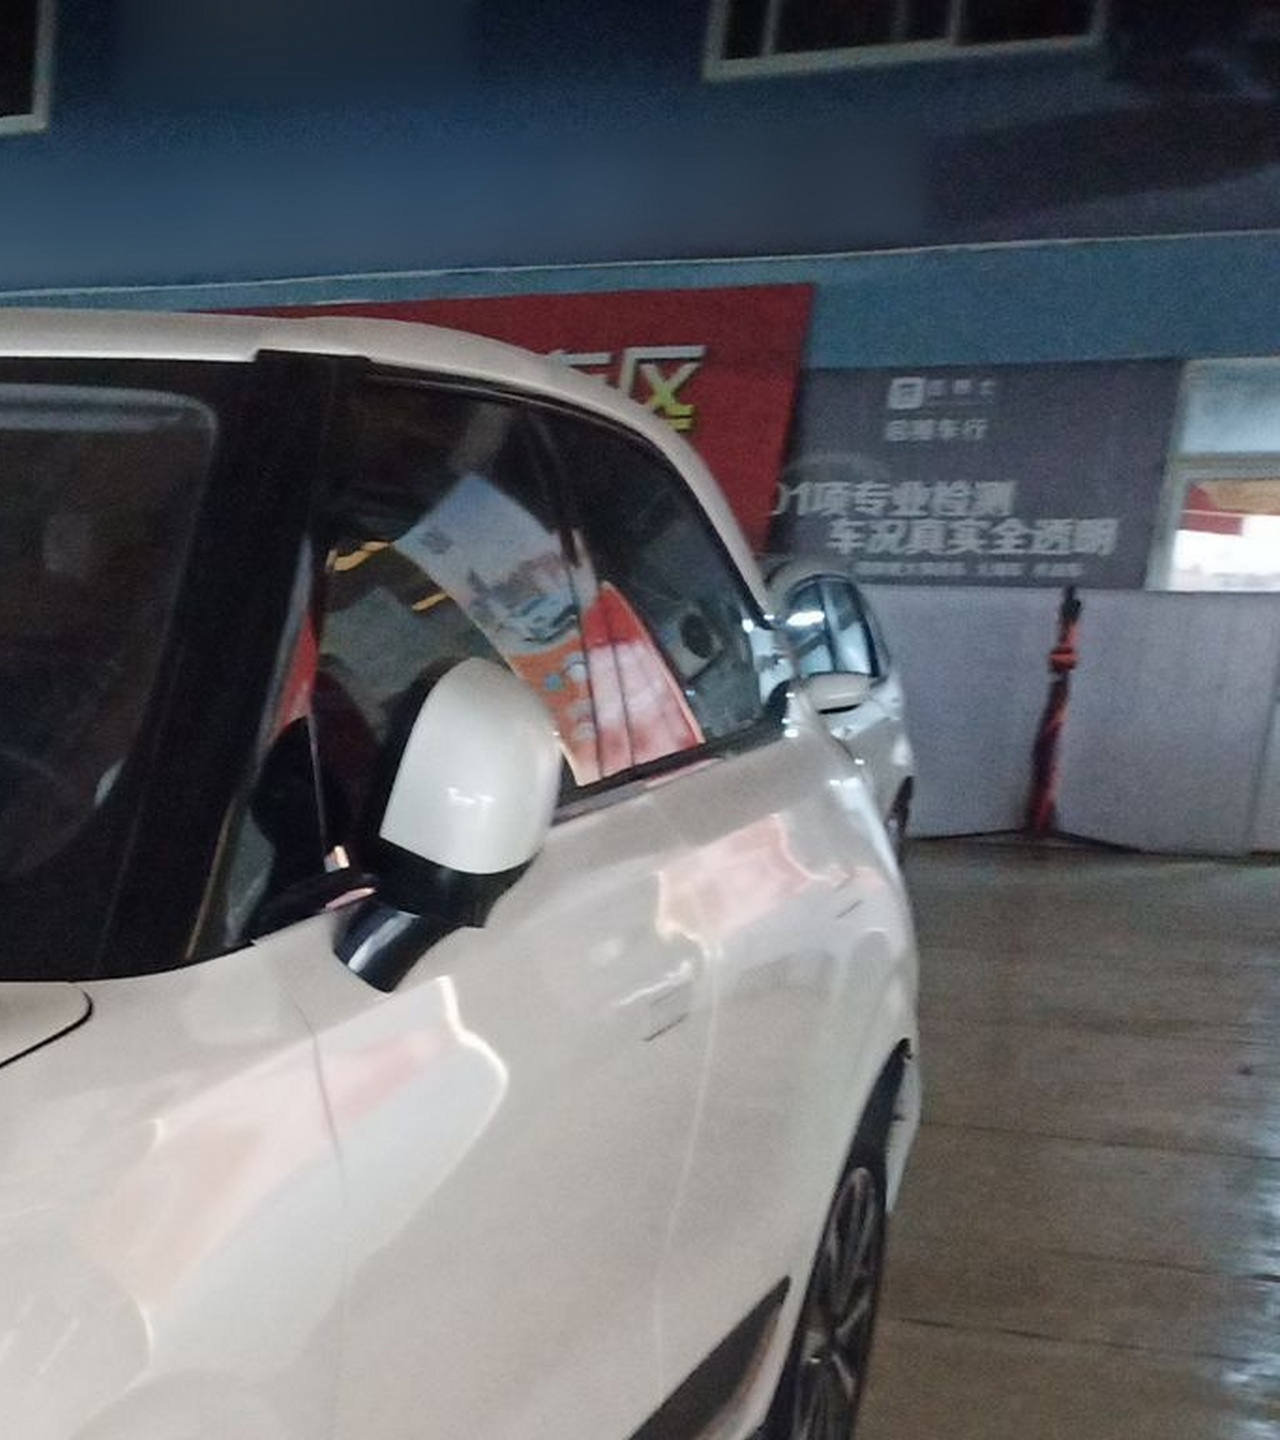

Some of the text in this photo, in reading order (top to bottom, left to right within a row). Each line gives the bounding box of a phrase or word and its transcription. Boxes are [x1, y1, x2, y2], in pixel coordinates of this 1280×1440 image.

[826, 517, 1121, 556] 车况真实全透明
